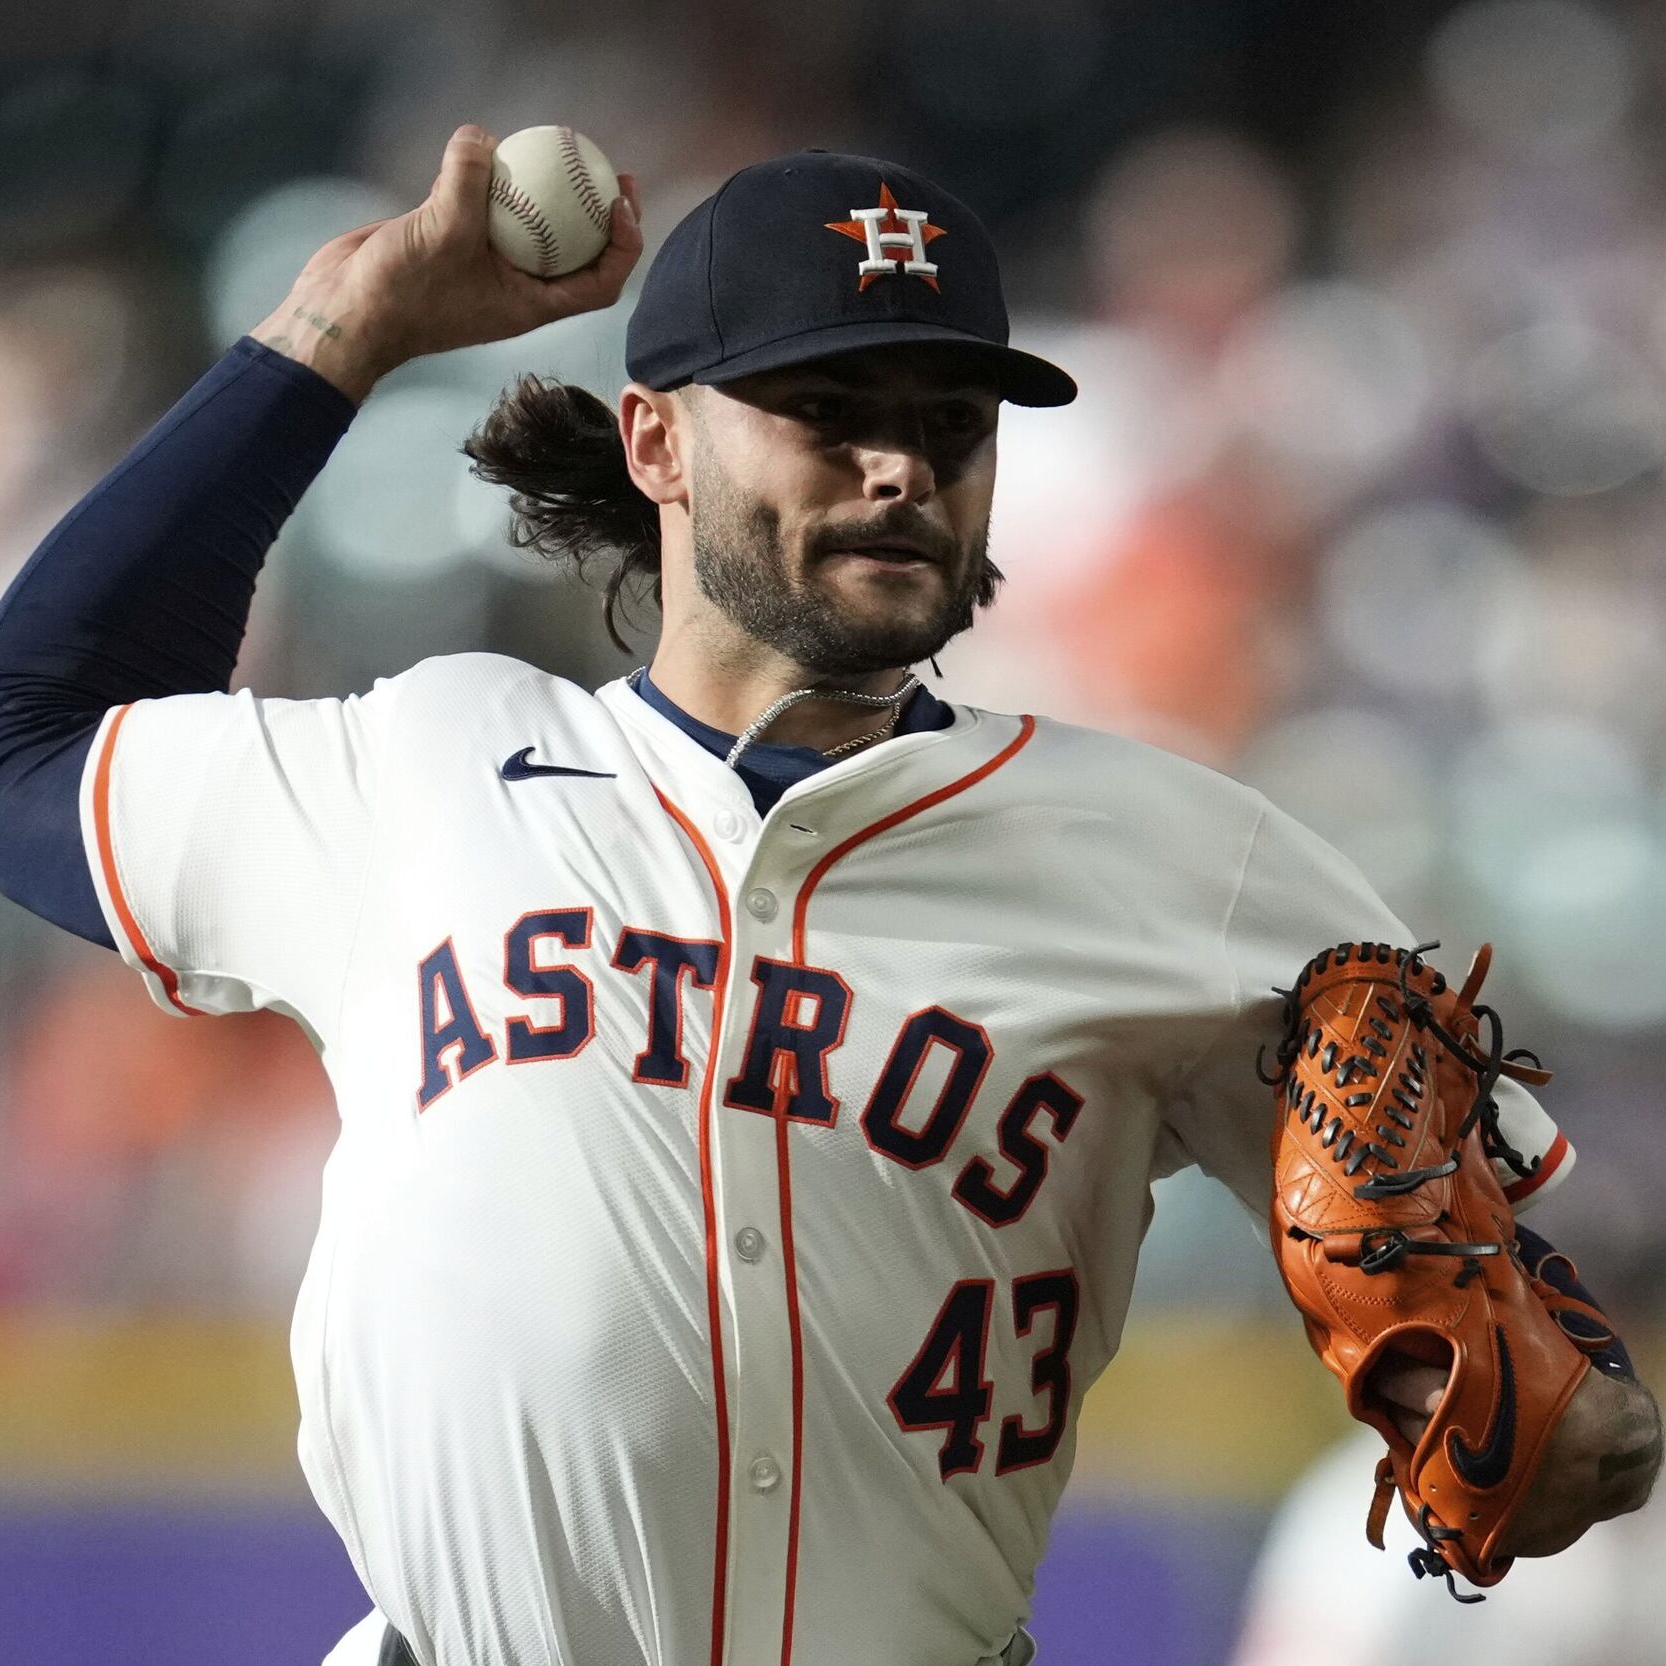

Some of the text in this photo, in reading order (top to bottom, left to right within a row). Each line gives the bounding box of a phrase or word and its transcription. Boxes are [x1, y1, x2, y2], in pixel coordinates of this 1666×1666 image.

[850, 207, 939, 277] H
[416, 905, 1086, 1230] ASTROS
[886, 1268, 1080, 1485] 43
